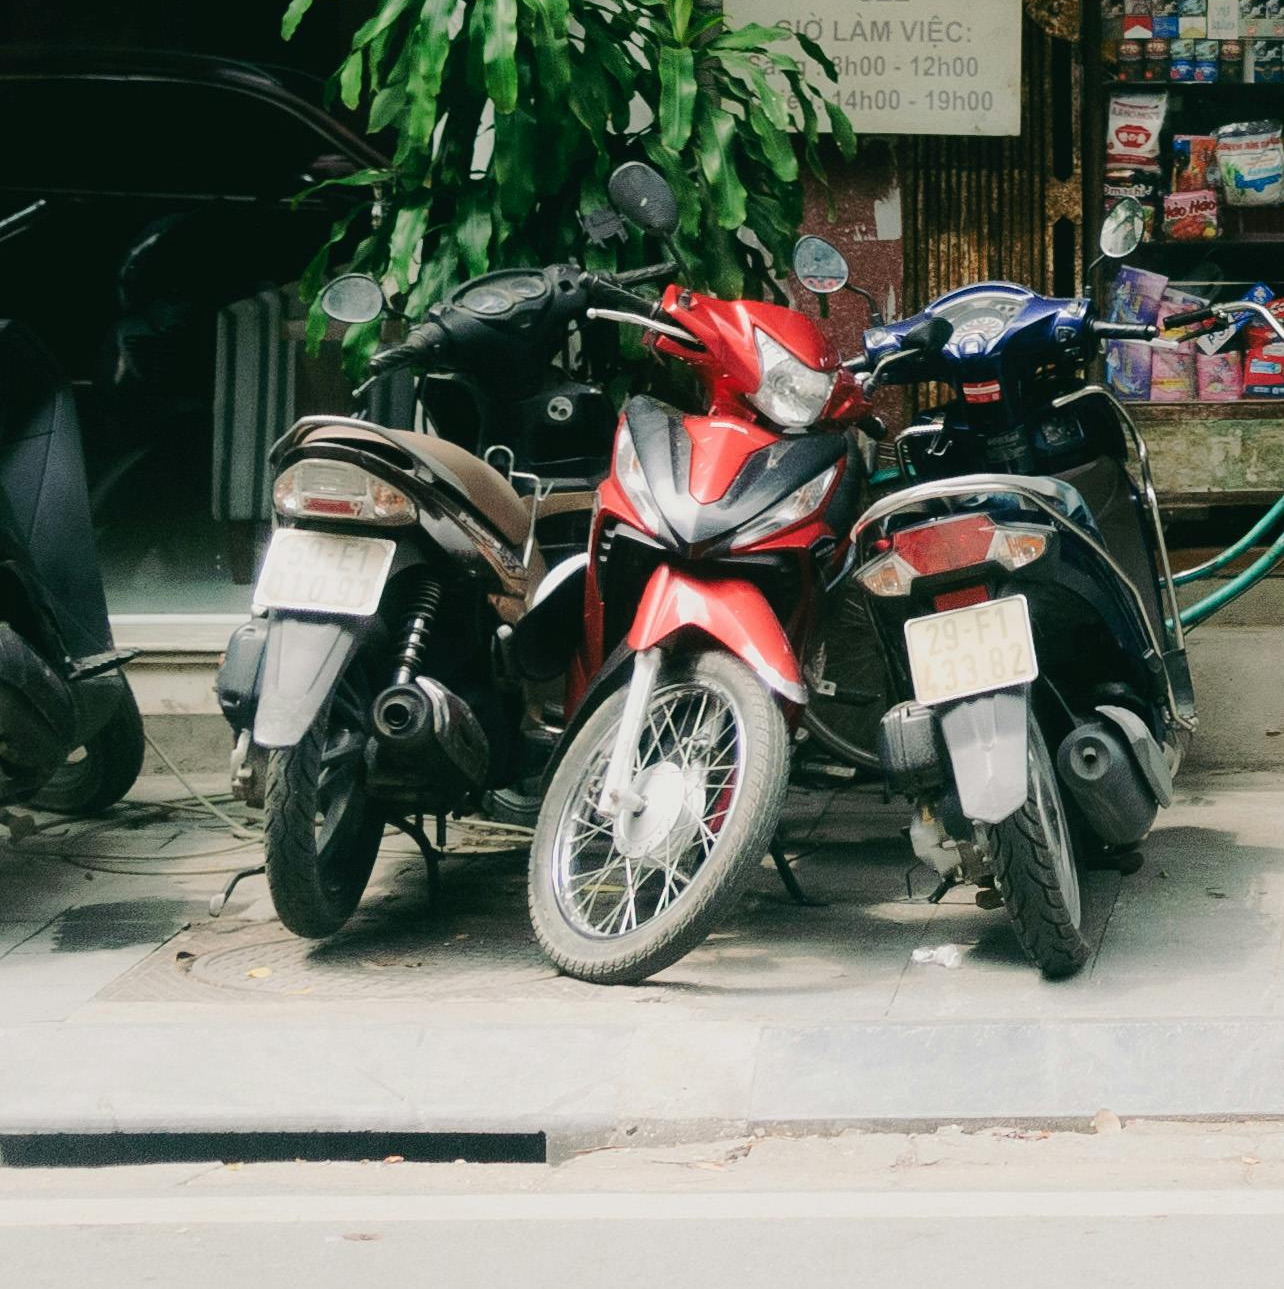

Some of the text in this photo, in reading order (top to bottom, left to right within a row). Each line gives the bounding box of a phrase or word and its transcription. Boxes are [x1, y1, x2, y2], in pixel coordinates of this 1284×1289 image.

[833, 14, 891, 43] LÀM
[909, 56, 979, 78] 12h00
[925, 90, 994, 112] 19h00
[924, 605, 1010, 658] 29-F1
